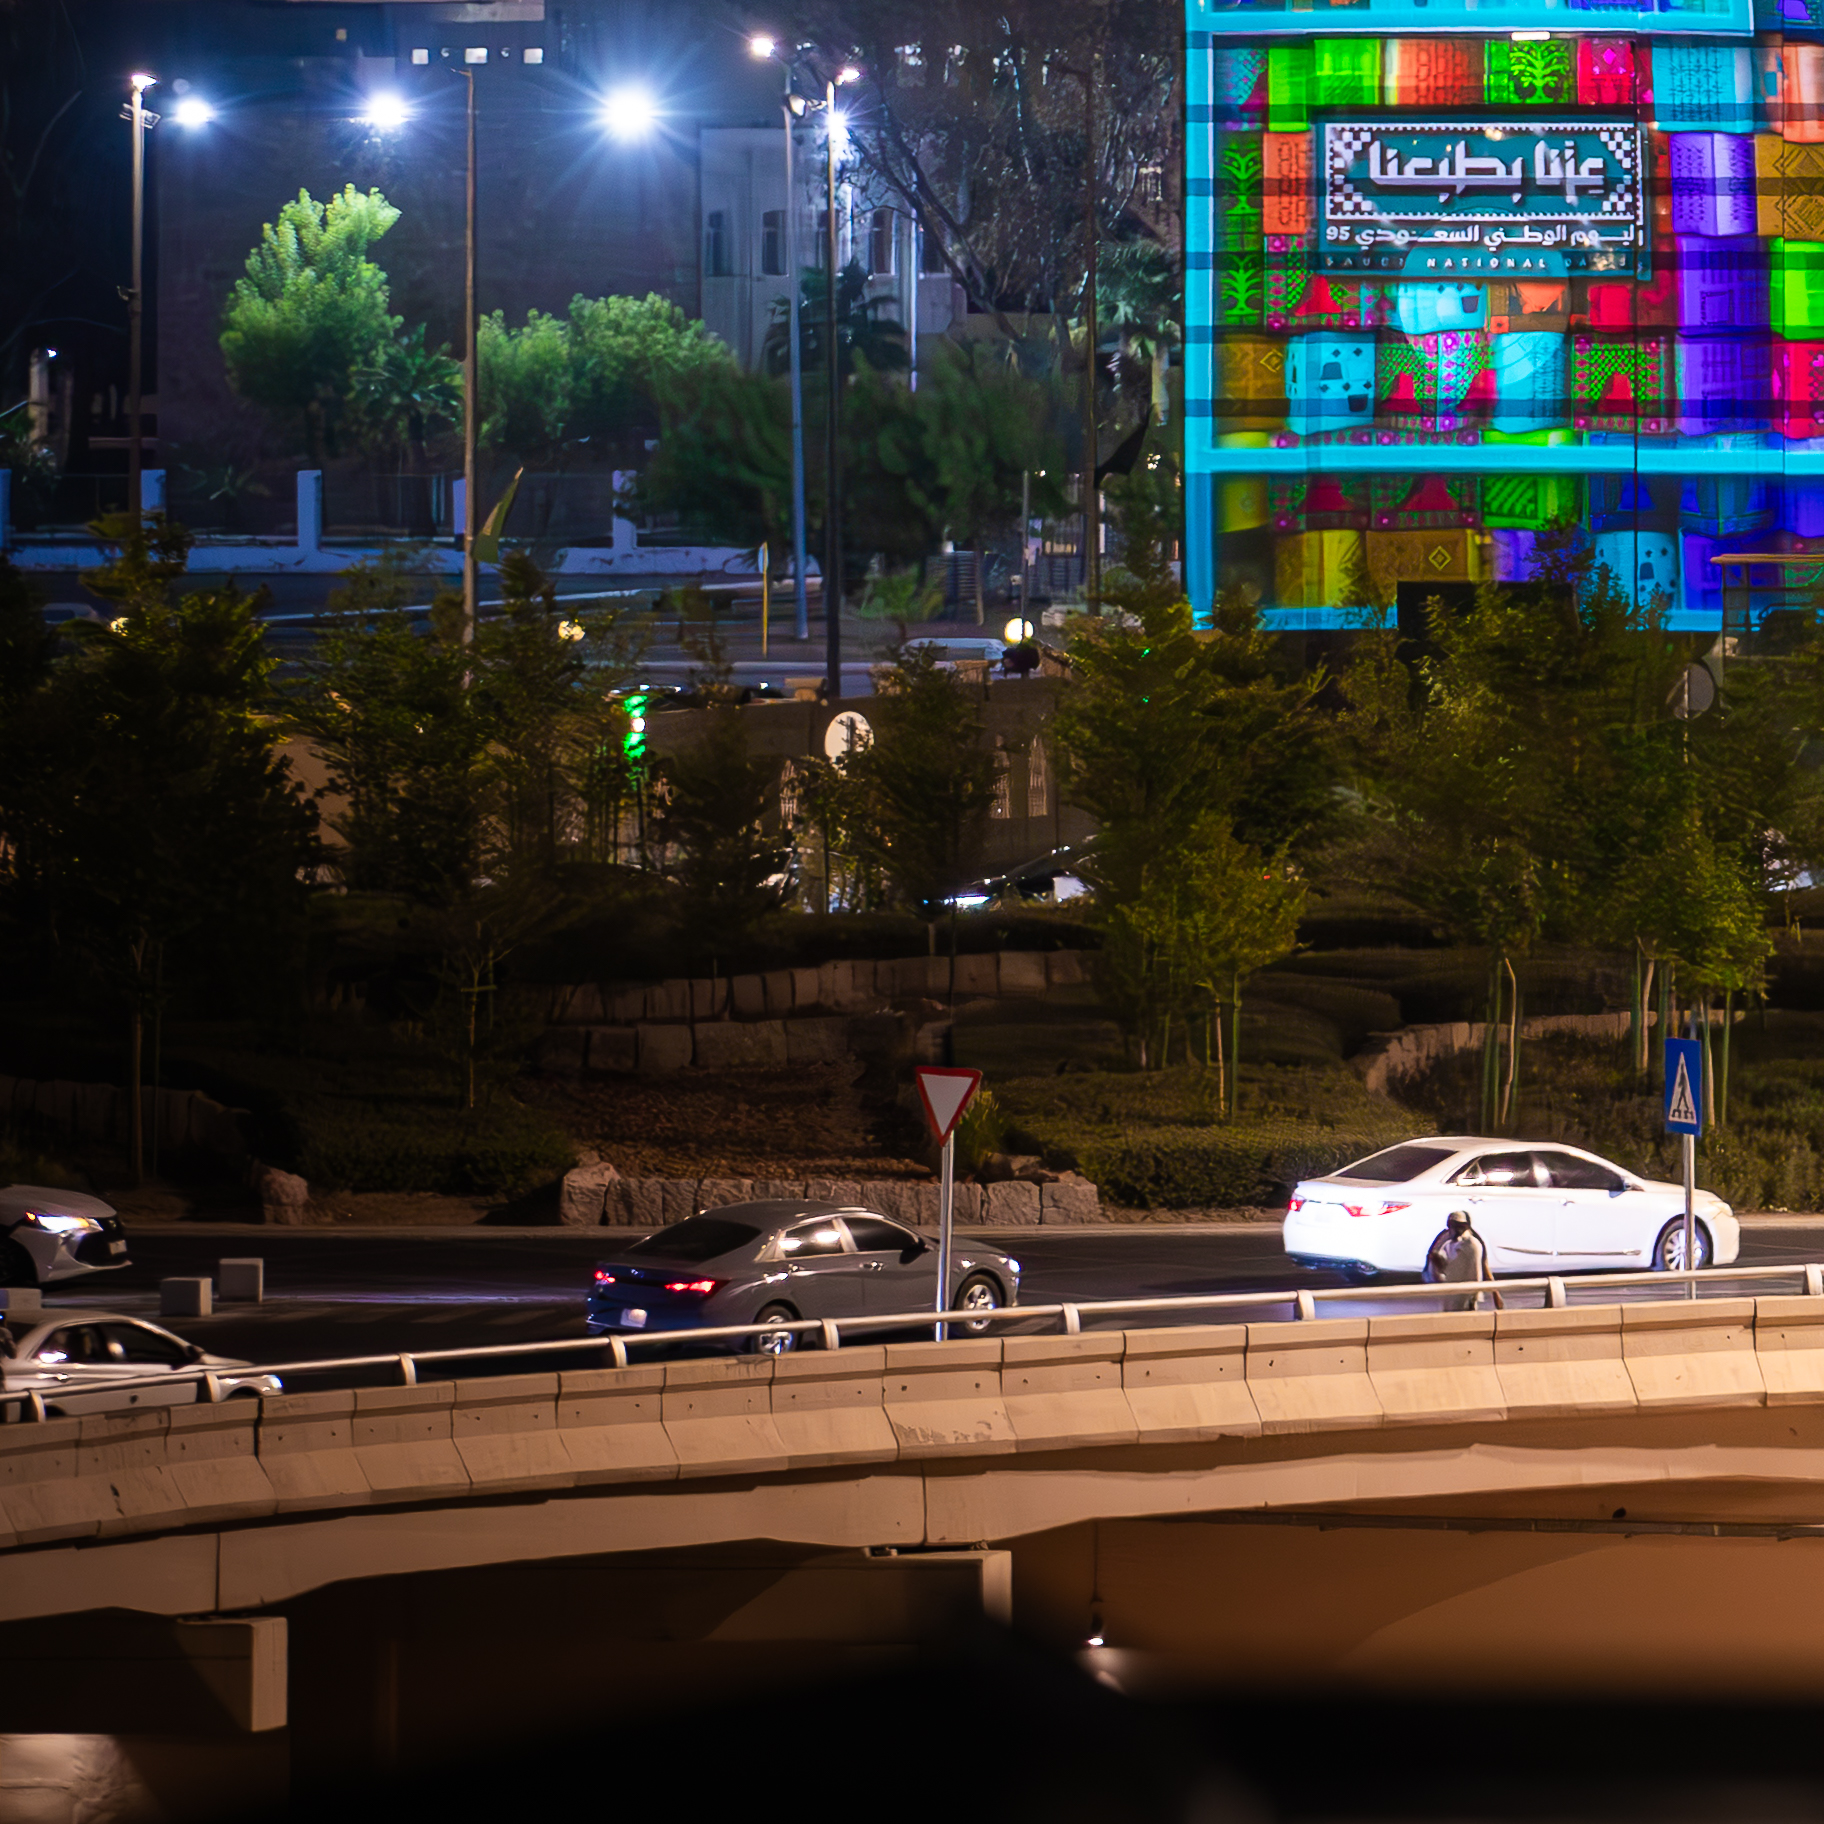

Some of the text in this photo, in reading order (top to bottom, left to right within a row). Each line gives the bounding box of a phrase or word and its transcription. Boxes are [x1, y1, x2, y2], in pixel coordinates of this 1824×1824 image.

[1369, 139, 1523, 203] بطبعنا
[1325, 223, 1644, 252] اليوم الوطني السعودي 95
[1427, 257, 1546, 269] NATIONAL
